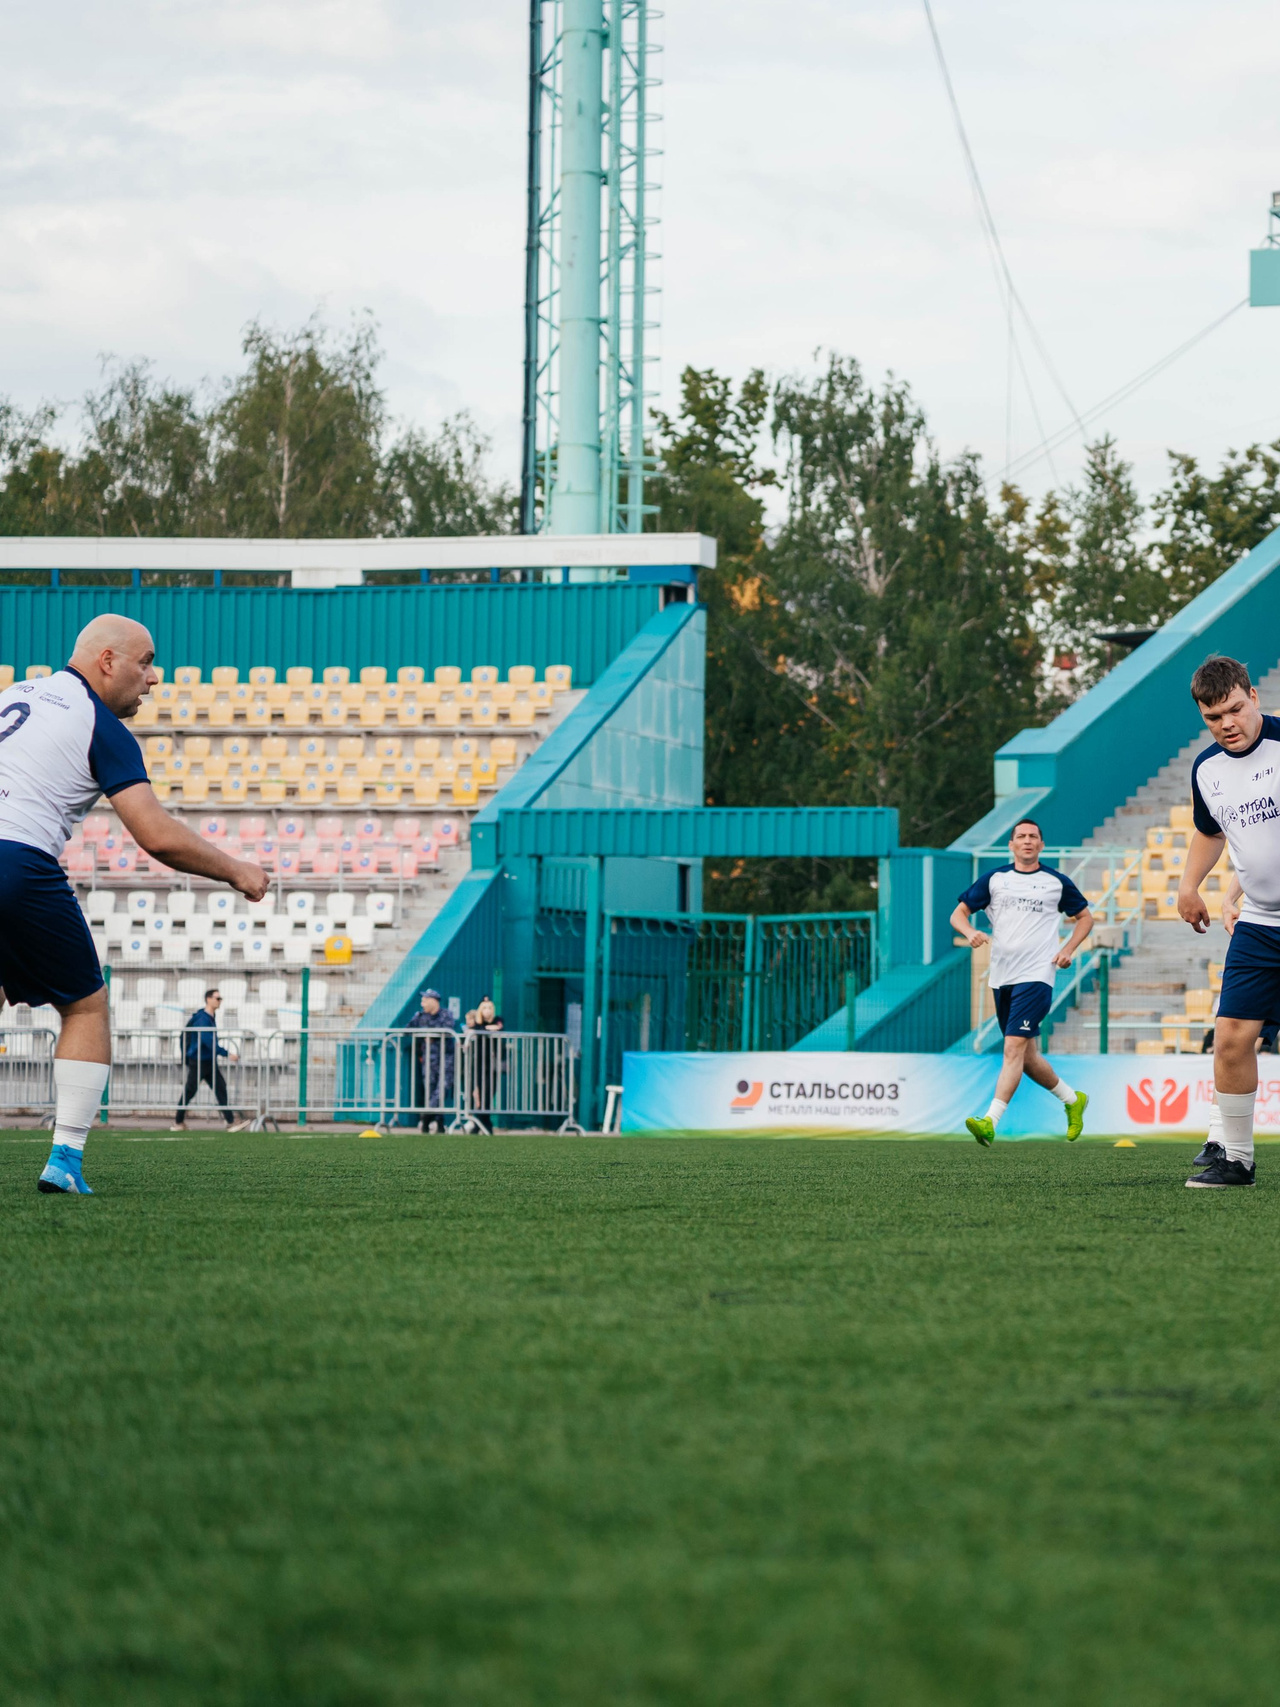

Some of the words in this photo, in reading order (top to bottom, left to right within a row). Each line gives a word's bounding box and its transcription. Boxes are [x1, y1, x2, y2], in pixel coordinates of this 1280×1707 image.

[1238, 796, 1275, 815] ФУТБОЛ
[1241, 819, 1247, 828] В
[770, 1081, 899, 1100] СТАЛЬСОЮЗ
[767, 1105, 812, 1117] МЕТАЛЛ
[815, 1105, 841, 1116] НАШ
[843, 1105, 899, 1117] ПРОФИЛЬ
